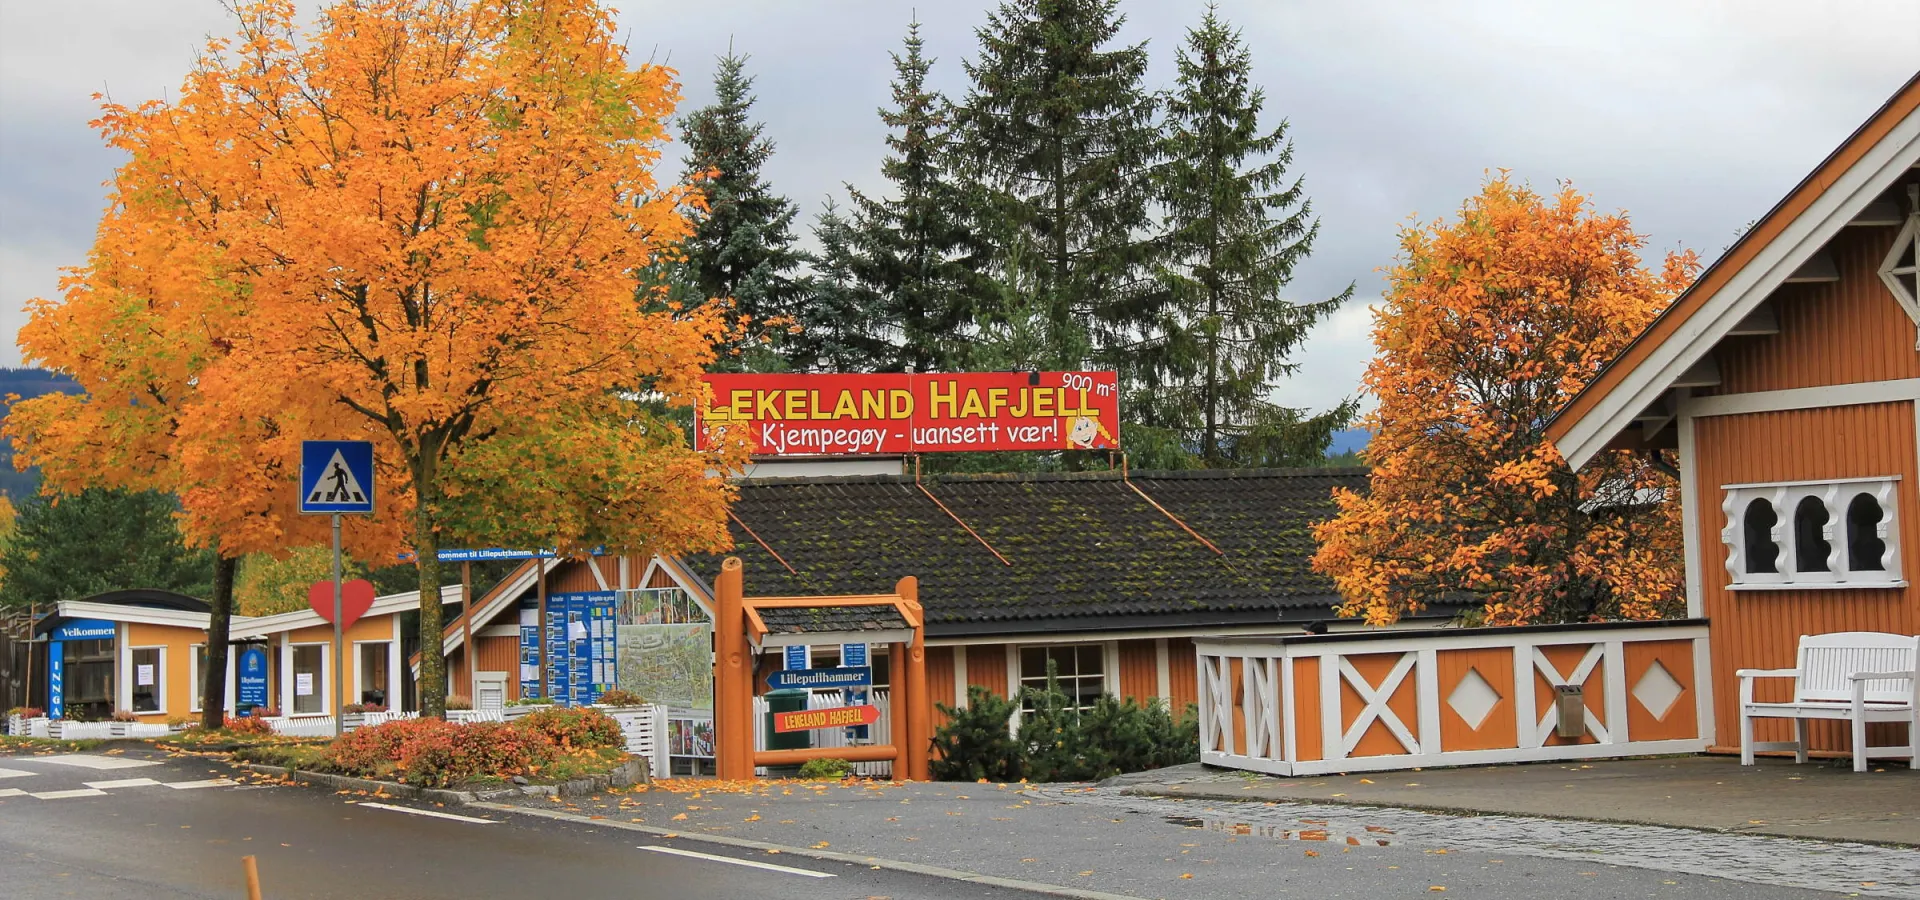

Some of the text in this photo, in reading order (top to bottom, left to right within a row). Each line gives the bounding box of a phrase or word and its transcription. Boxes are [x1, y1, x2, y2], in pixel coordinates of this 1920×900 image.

[1062, 373, 1093, 392] 900
[702, 381, 1100, 421] LEKELAND HAFJELL
[762, 423, 887, 453] Kjempegøy
[913, 419, 998, 446] uansett
[1007, 418, 1058, 443] vær!
[62, 628, 115, 637] Velkommen
[780, 672, 864, 686] Lilleputthammer
[784, 708, 863, 730] LEKELAND HAFJELL
